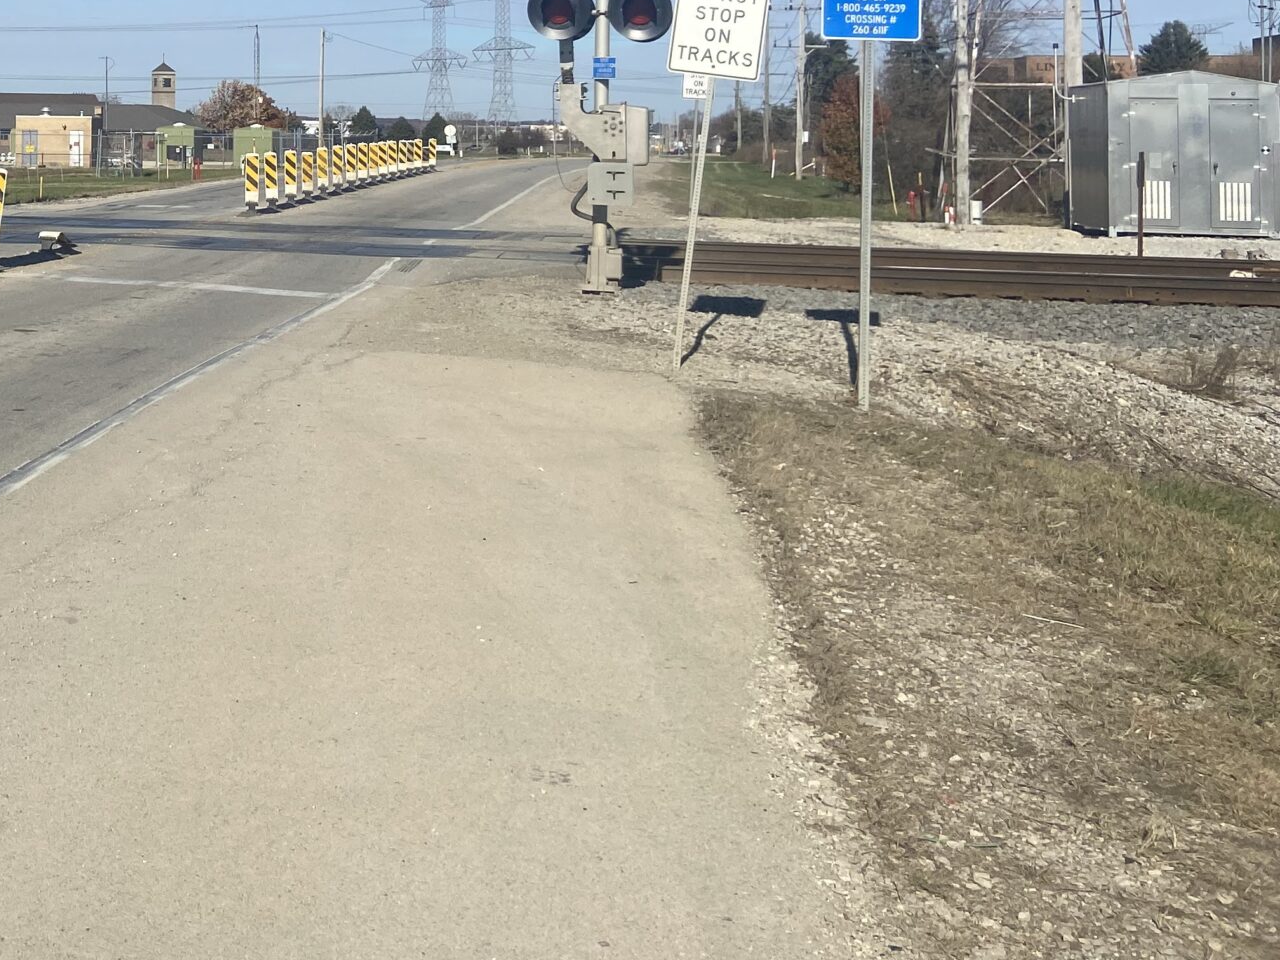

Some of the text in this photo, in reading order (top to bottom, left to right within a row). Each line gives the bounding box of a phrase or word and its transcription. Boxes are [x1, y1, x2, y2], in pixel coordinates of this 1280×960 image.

[836, 3, 906, 13] 1-800-465-9239
[695, 5, 746, 24] STOP
[845, 15, 887, 24] CROSSING
[852, 25, 870, 34] 260
[704, 27, 731, 44] ON
[677, 45, 753, 68] TRACKS
[685, 87, 707, 95] TRACK
